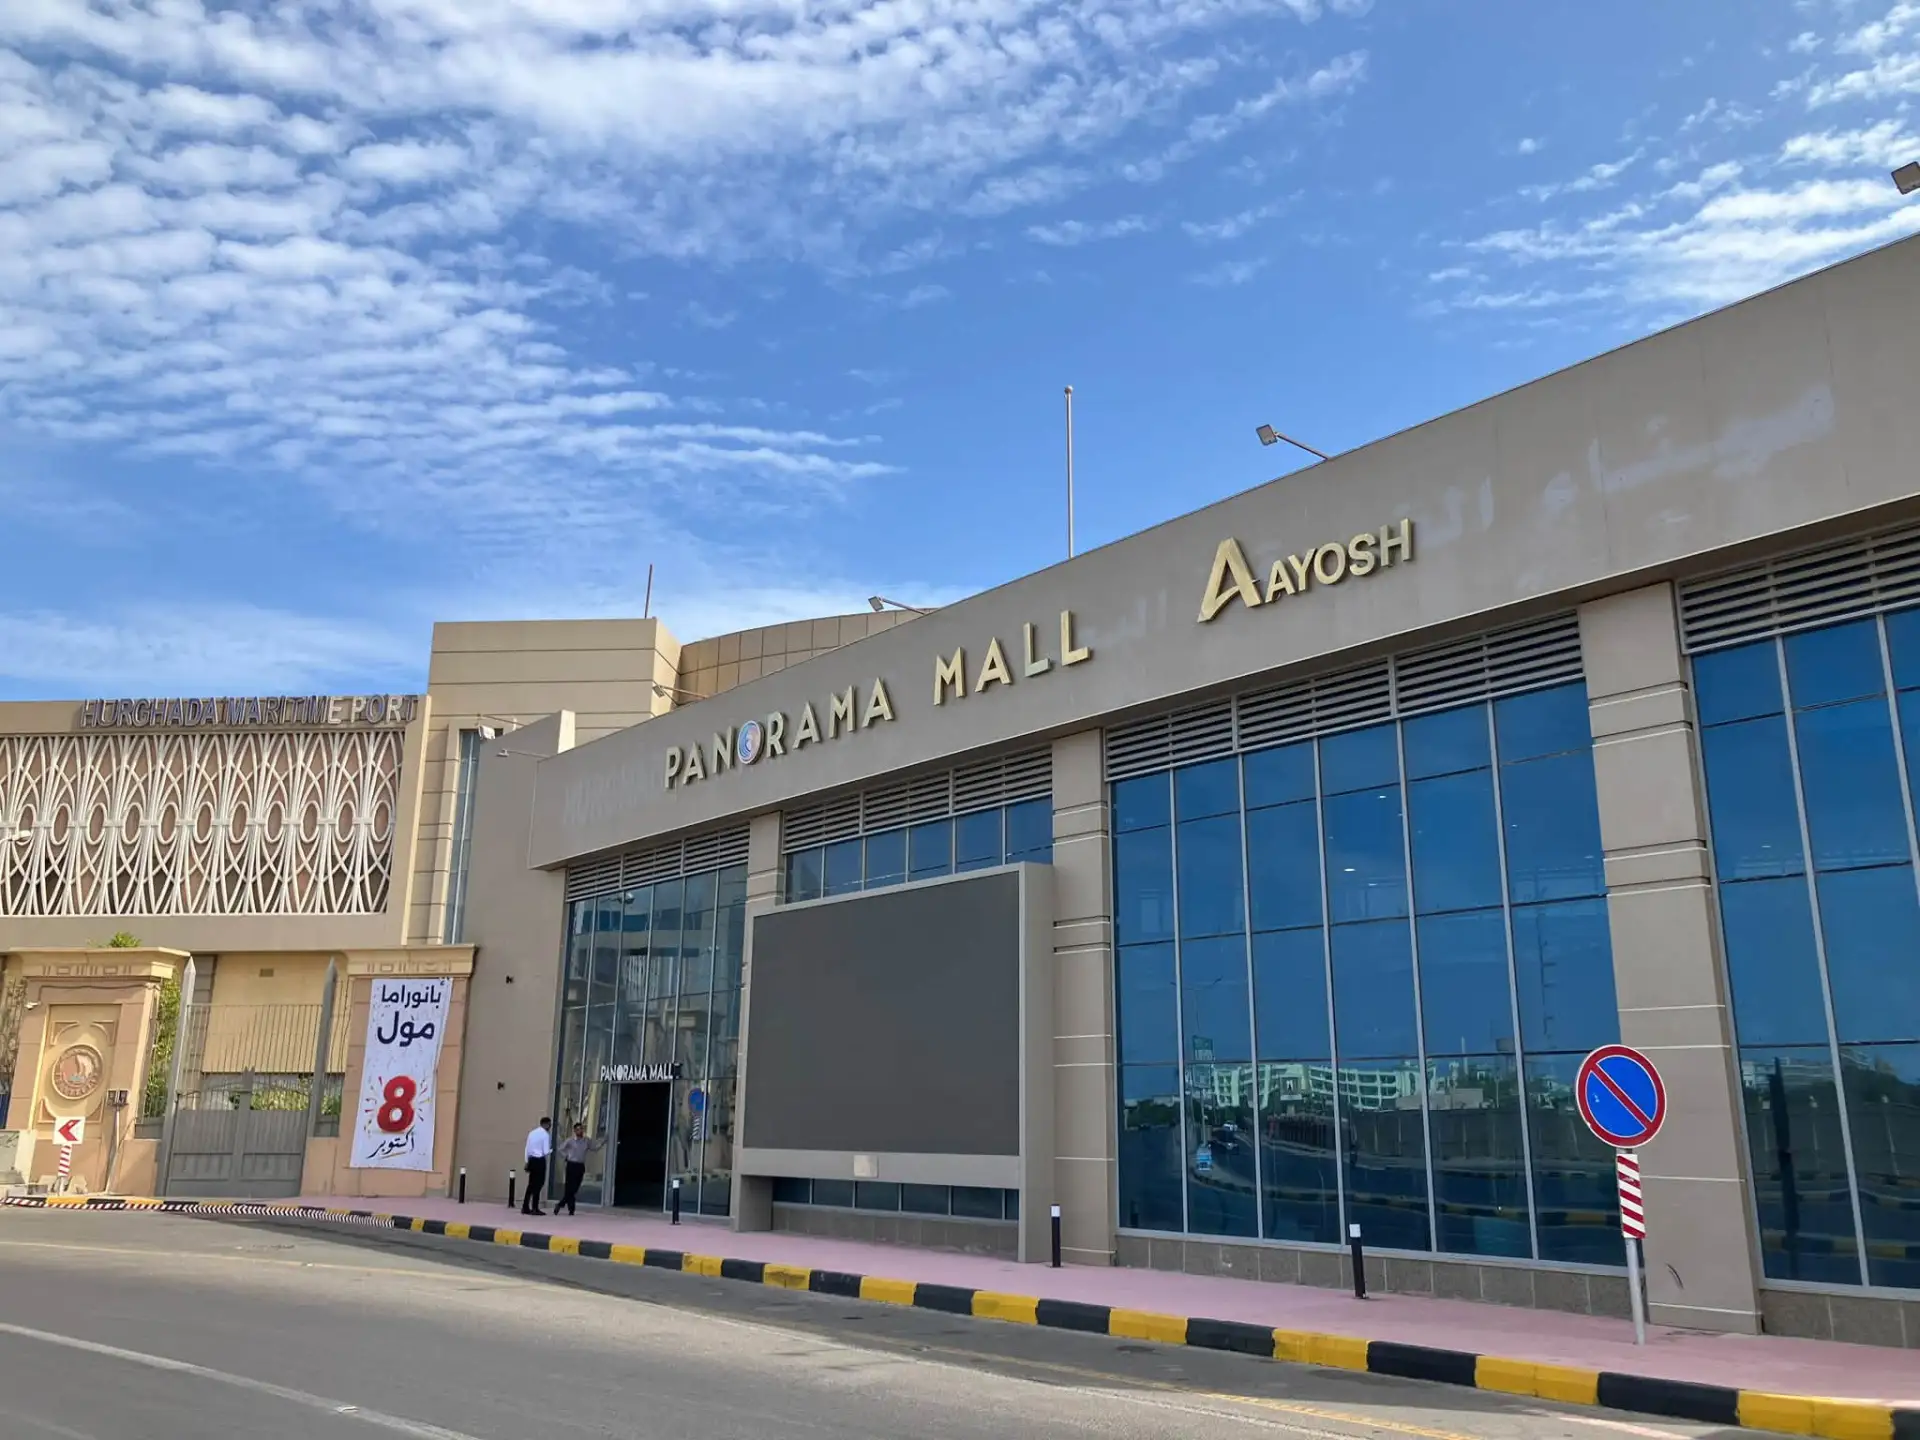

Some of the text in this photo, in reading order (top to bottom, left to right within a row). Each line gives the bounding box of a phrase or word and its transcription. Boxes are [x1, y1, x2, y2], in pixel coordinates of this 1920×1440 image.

[80, 694, 418, 728] HURGHADA MARITIME PORT
[664, 609, 1092, 790] PANORAMA MALL
[381, 984, 442, 1009] بانوراما
[377, 1011, 435, 1047] مول
[600, 1062, 674, 1081] PANORAMA MALL
[376, 1075, 417, 1134] 8
